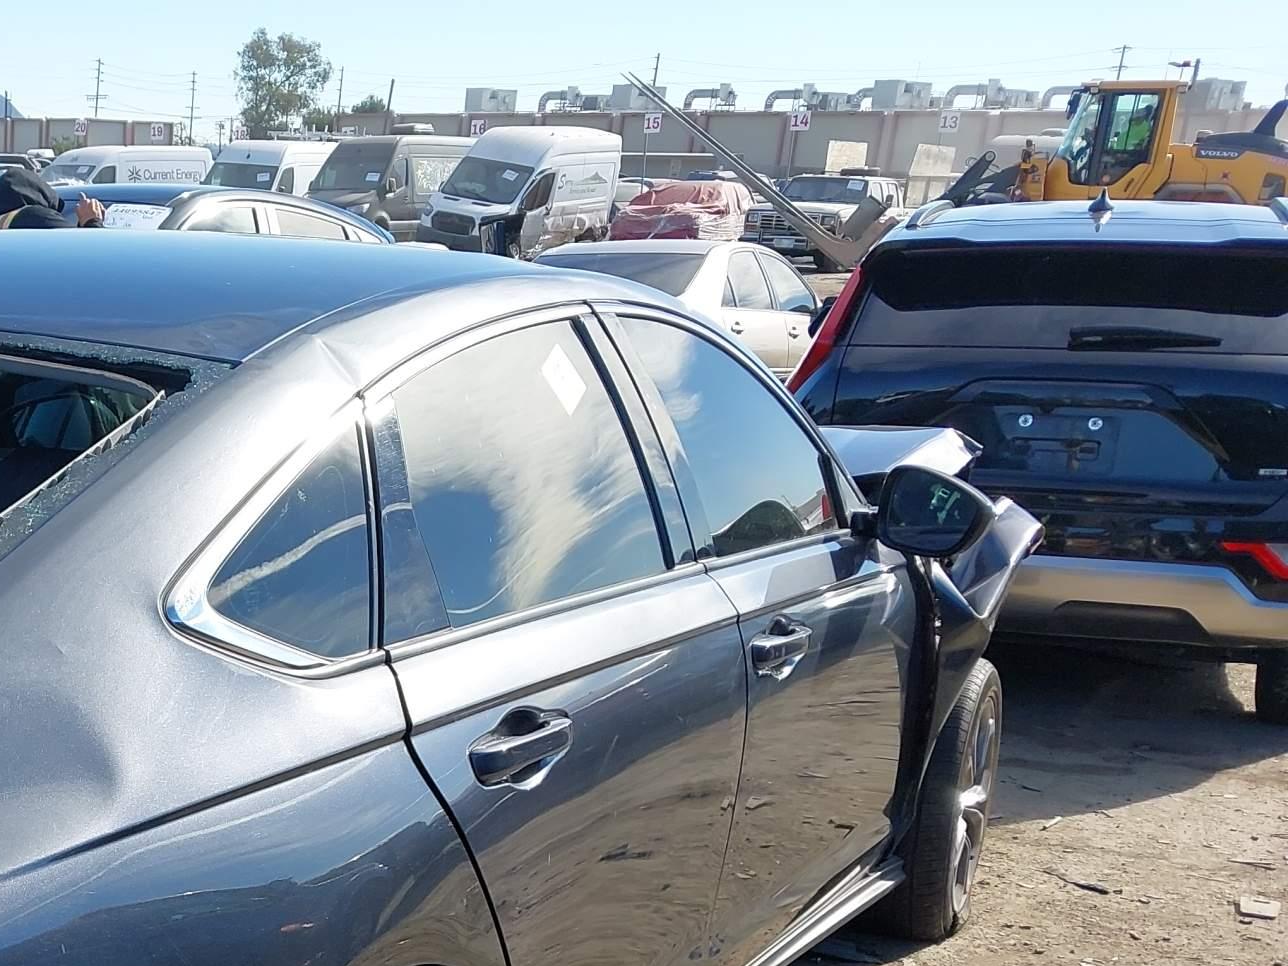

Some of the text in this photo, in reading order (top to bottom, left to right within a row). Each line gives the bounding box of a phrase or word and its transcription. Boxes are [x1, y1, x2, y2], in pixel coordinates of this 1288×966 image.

[75, 121, 87, 133] 20
[644, 117, 661, 130] 15
[790, 114, 809, 128] 14
[939, 115, 959, 129] 13
[151, 126, 163, 137] 19
[471, 124, 486, 136] 16
[1200, 150, 1238, 158] VOLVO
[143, 168, 202, 184] Current Energy
